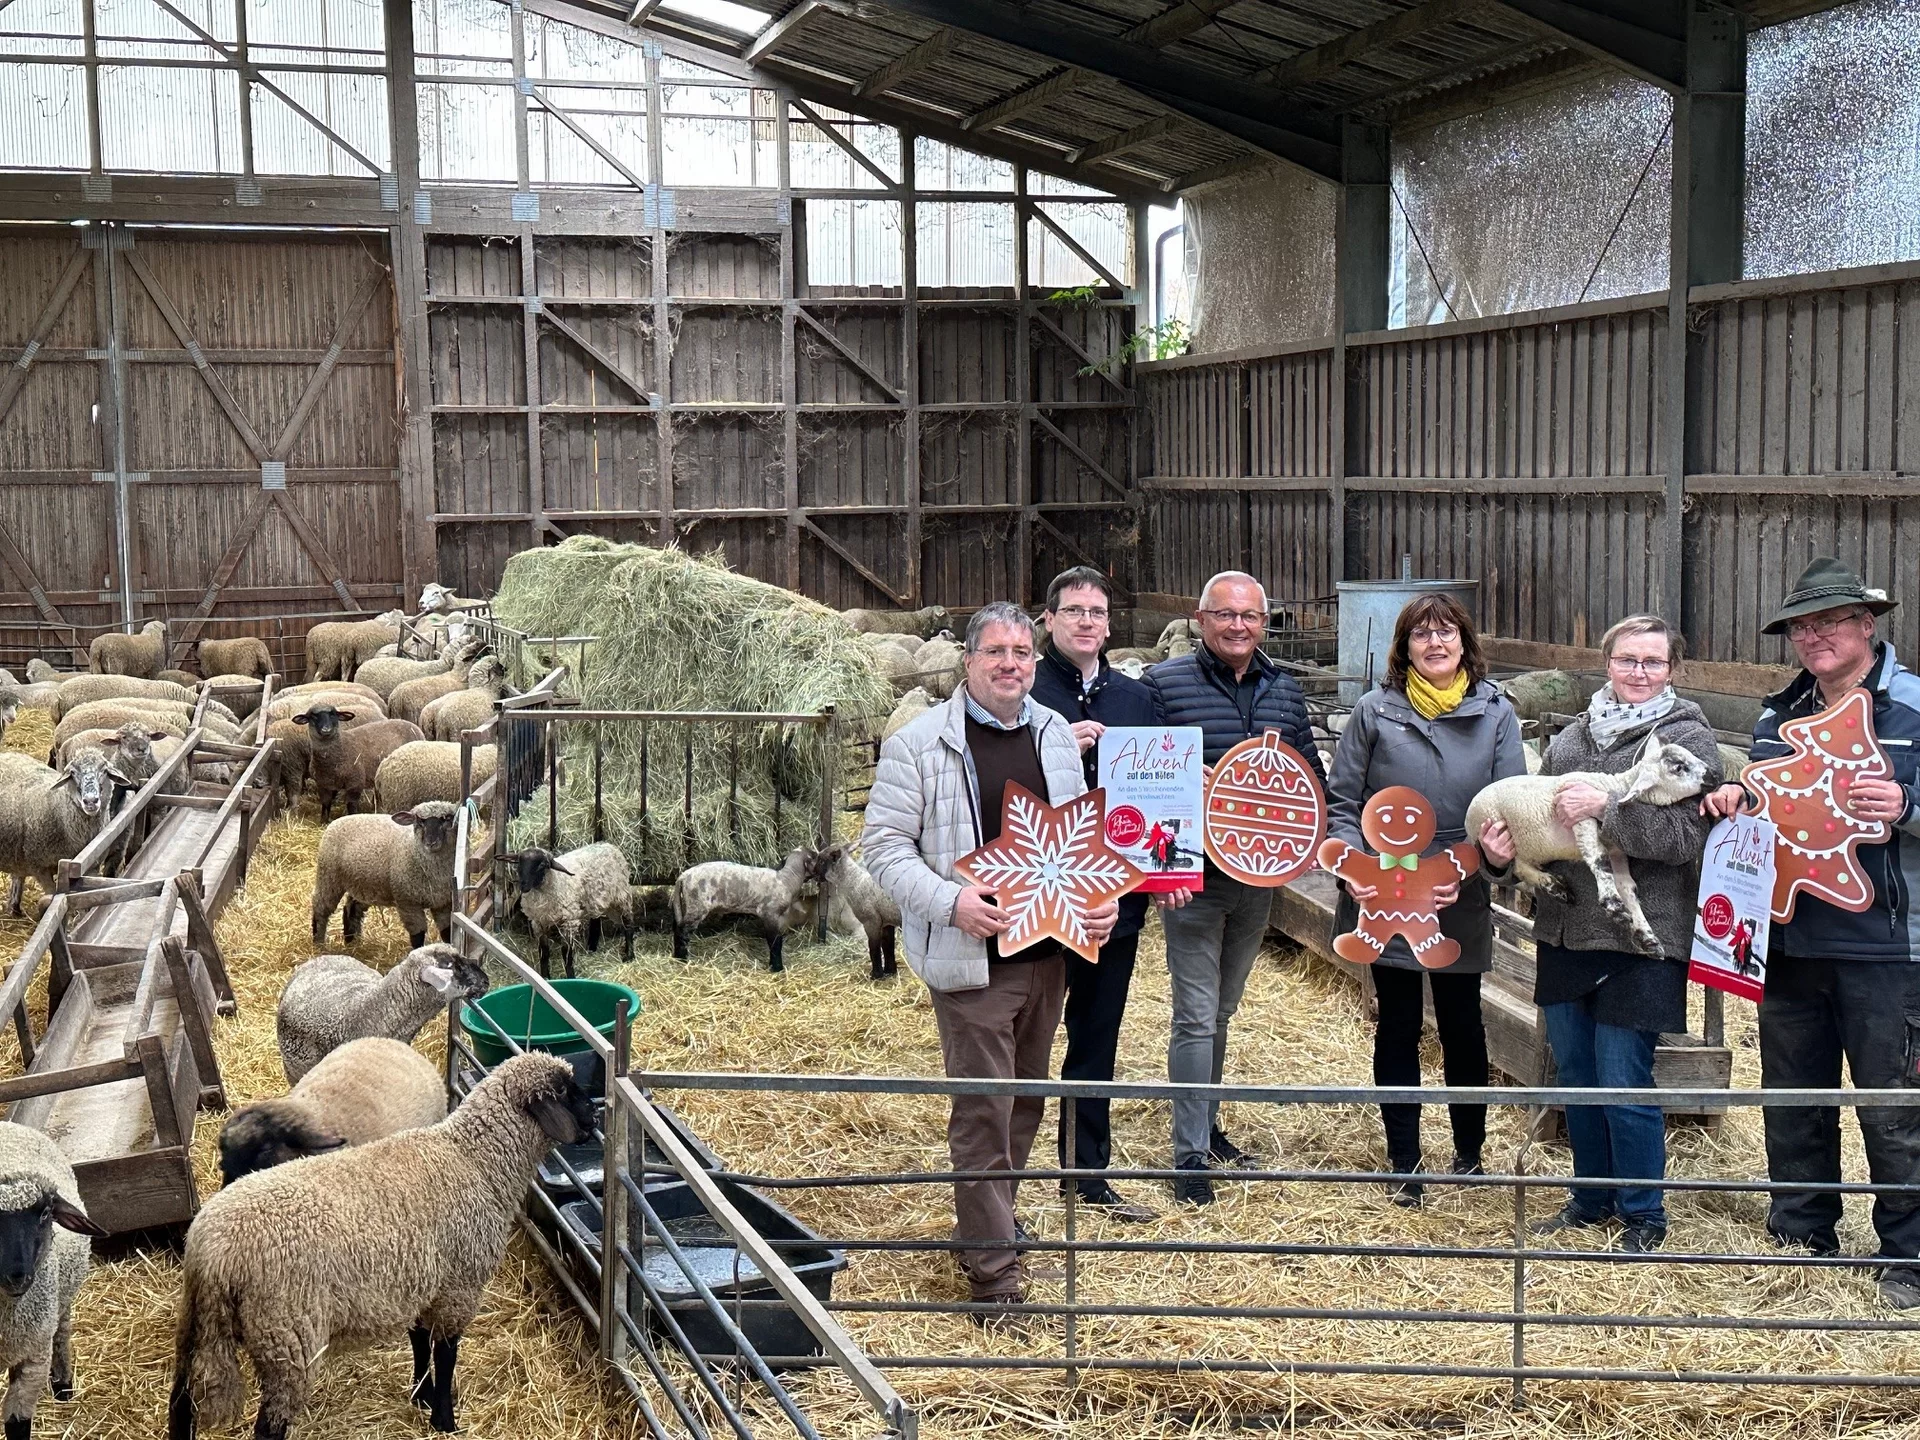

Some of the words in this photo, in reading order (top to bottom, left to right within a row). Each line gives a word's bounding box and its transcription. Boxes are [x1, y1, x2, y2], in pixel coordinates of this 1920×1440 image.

[1110, 737, 1196, 779] Advent
[1126, 771, 1138, 780] auf
[1140, 771, 1153, 780] den
[1714, 824, 1771, 871] Advent
